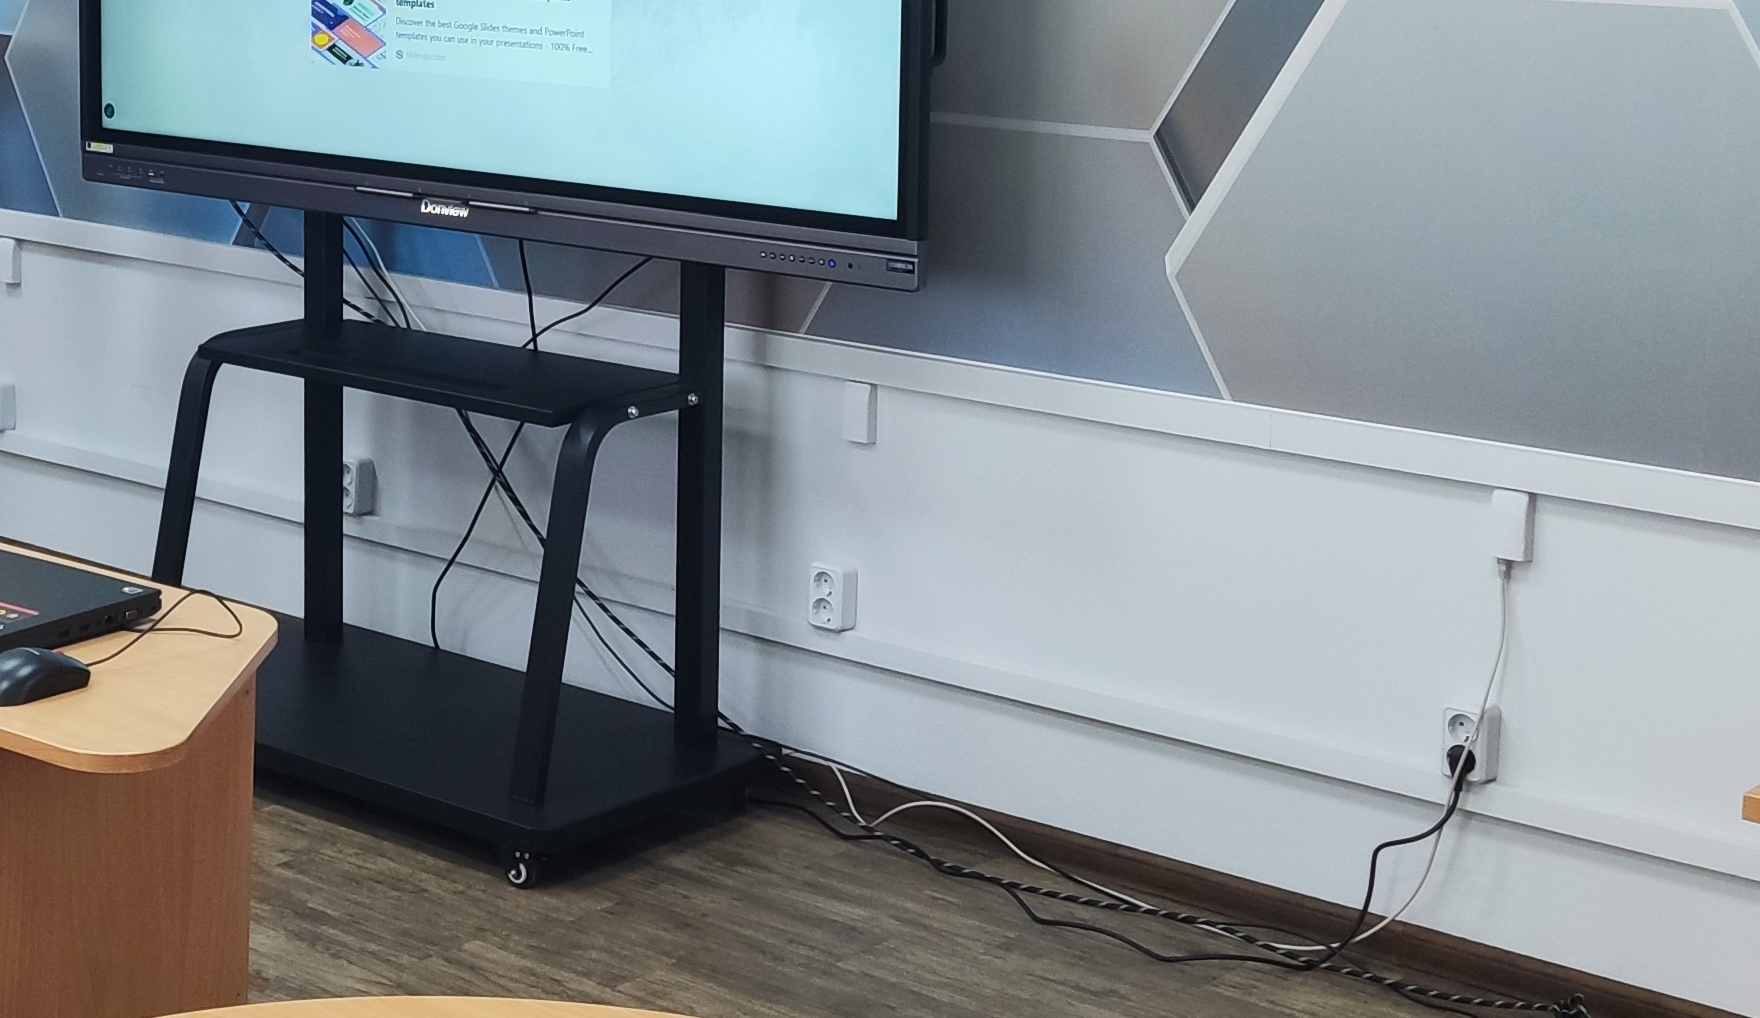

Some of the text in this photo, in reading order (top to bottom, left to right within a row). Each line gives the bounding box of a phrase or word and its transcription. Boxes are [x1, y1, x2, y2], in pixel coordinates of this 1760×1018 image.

[396, 17, 585, 38] Discover the best Google Slides themes and PowerPoint
[396, 31, 427, 41] templates
[429, 35, 442, 43] you
[479, 39, 494, 47] your
[496, 40, 543, 50] presentations
[550, 42, 570, 52] 100%
[421, 199, 470, 218] Donview
